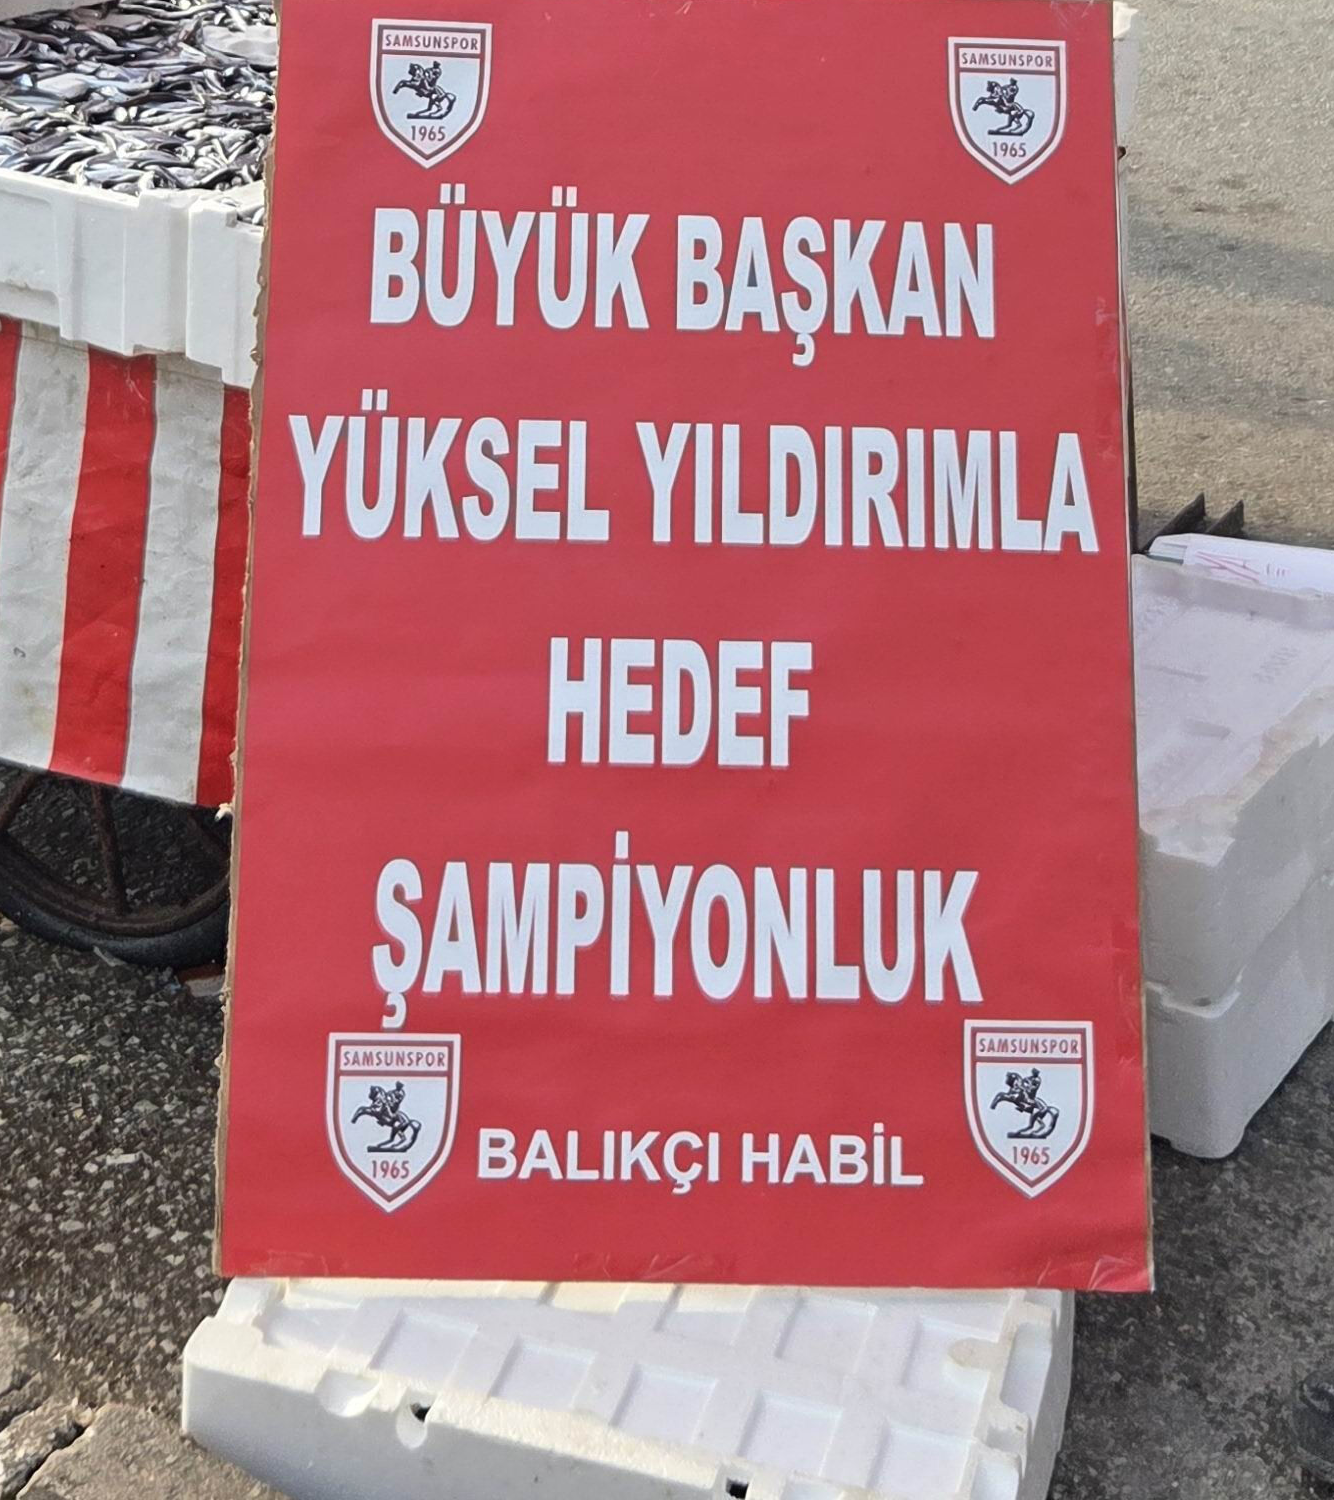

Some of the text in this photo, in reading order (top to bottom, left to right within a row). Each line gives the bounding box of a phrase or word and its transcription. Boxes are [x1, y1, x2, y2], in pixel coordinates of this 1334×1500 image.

[385, 33, 479, 51] SAMSUNSPOR
[961, 52, 1053, 68] SAMSUNSPOR
[410, 125, 446, 142] 1965
[992, 141, 1027, 158] 1965
[369, 184, 996, 367] BÜYÜK BAŞKAN
[288, 389, 1101, 554] YÜKSEL YILDIRIMLA
[546, 636, 814, 768] HEDEF
[370, 830, 985, 1030] ŞAMPİYONLUK
[978, 1037, 1079, 1055] SAMSUNSPOR
[343, 1050, 446, 1068] SAMSUNSPOR
[476, 1121, 926, 1194] BALIKÇI HABİL
[1011, 1145, 1051, 1166] 1965
[371, 1159, 410, 1180] 1965
